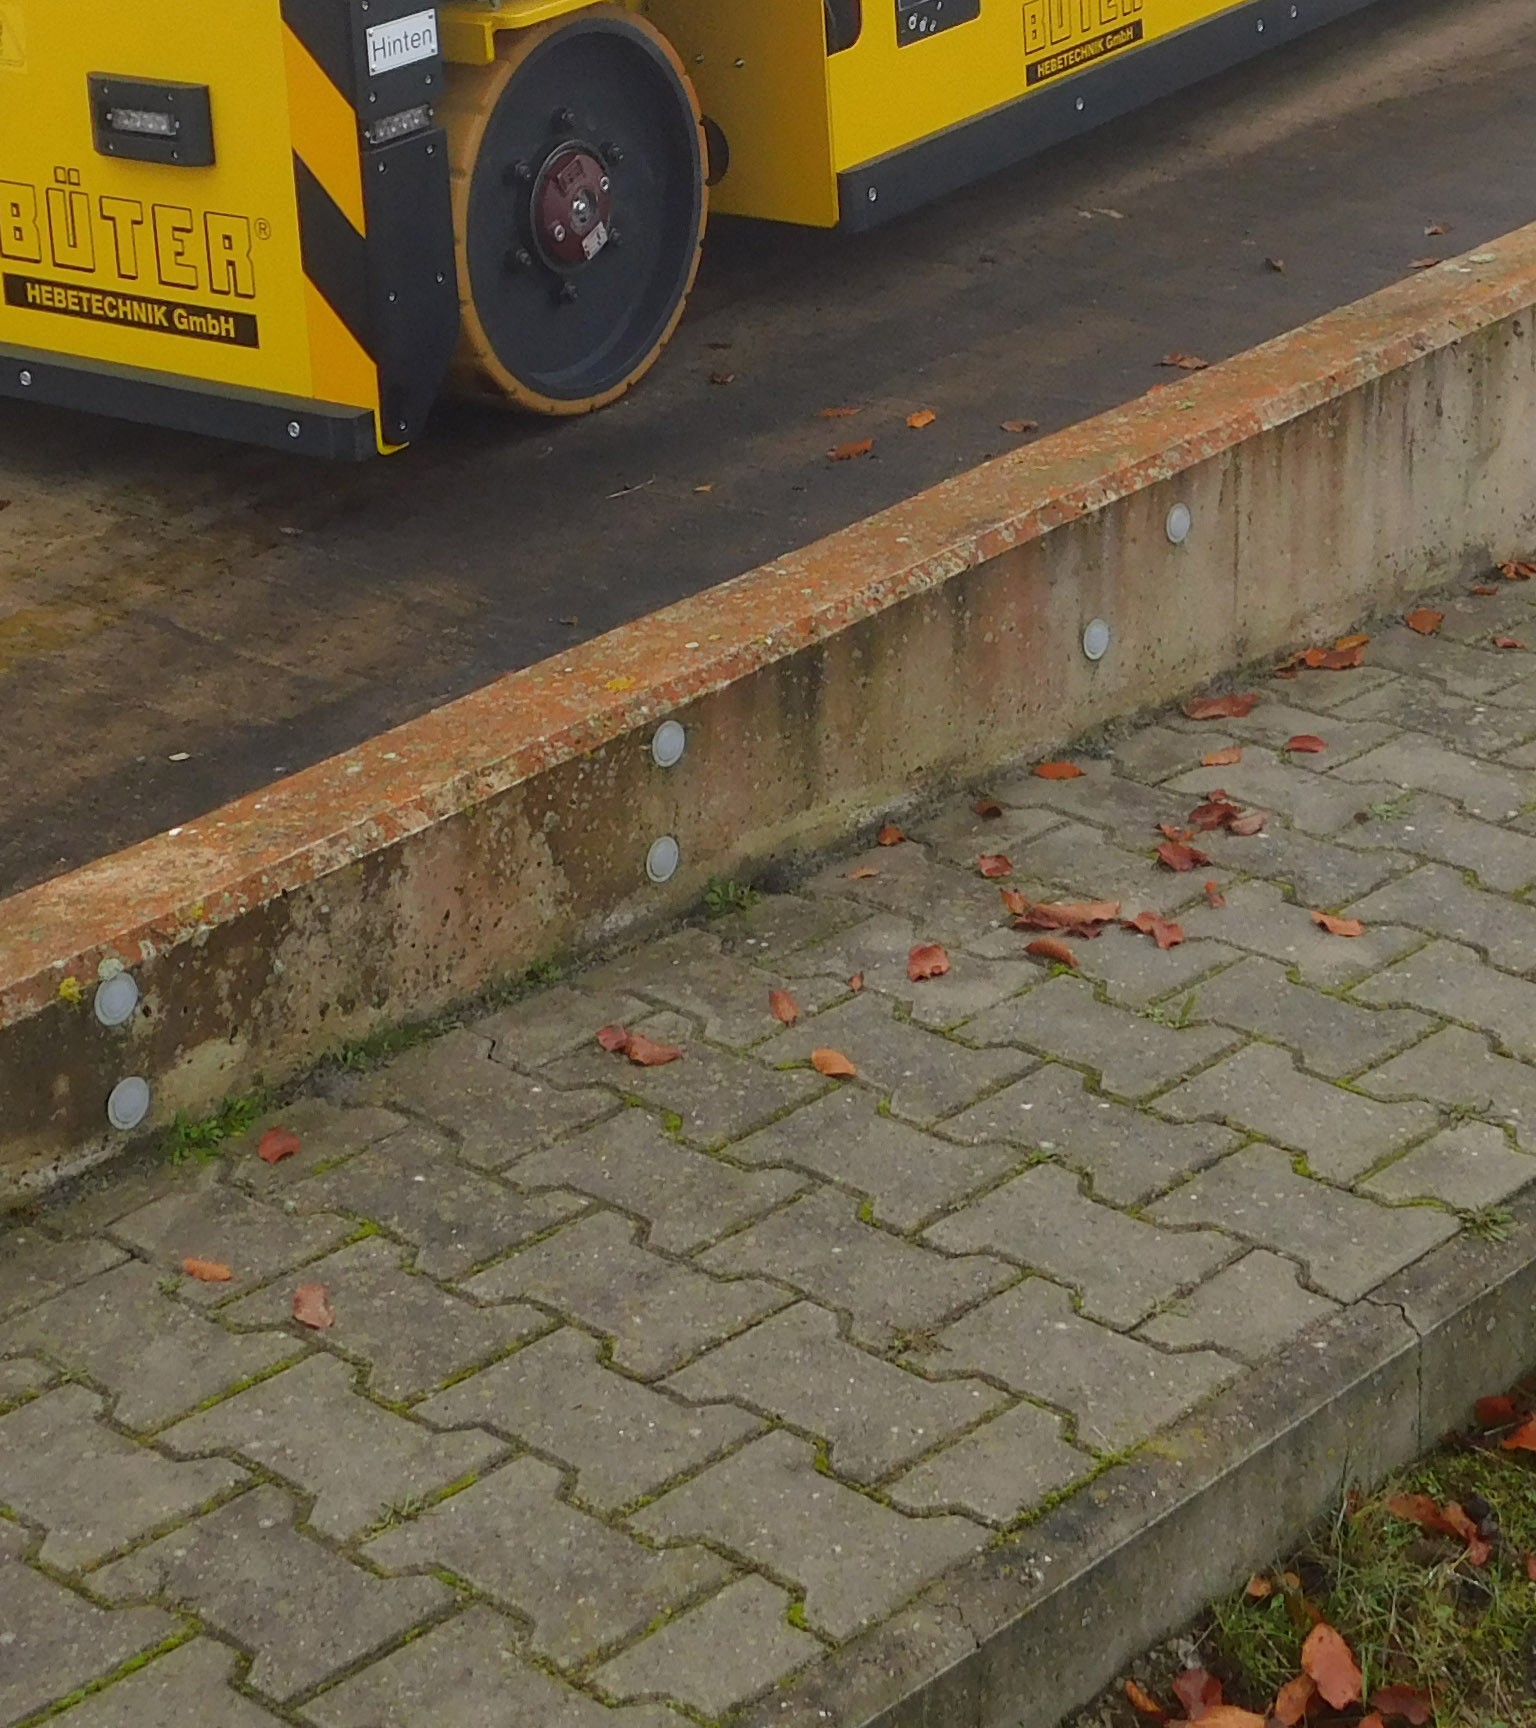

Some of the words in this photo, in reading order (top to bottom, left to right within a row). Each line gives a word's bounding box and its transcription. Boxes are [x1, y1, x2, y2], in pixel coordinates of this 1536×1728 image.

[372, 28, 432, 62] Hinten
[1037, 38, 1105, 78] HEBETECHNIK
[1105, 25, 1134, 49] GmbH
[25, 282, 170, 327] HEBETECHNIK
[173, 308, 236, 338] GmbH
